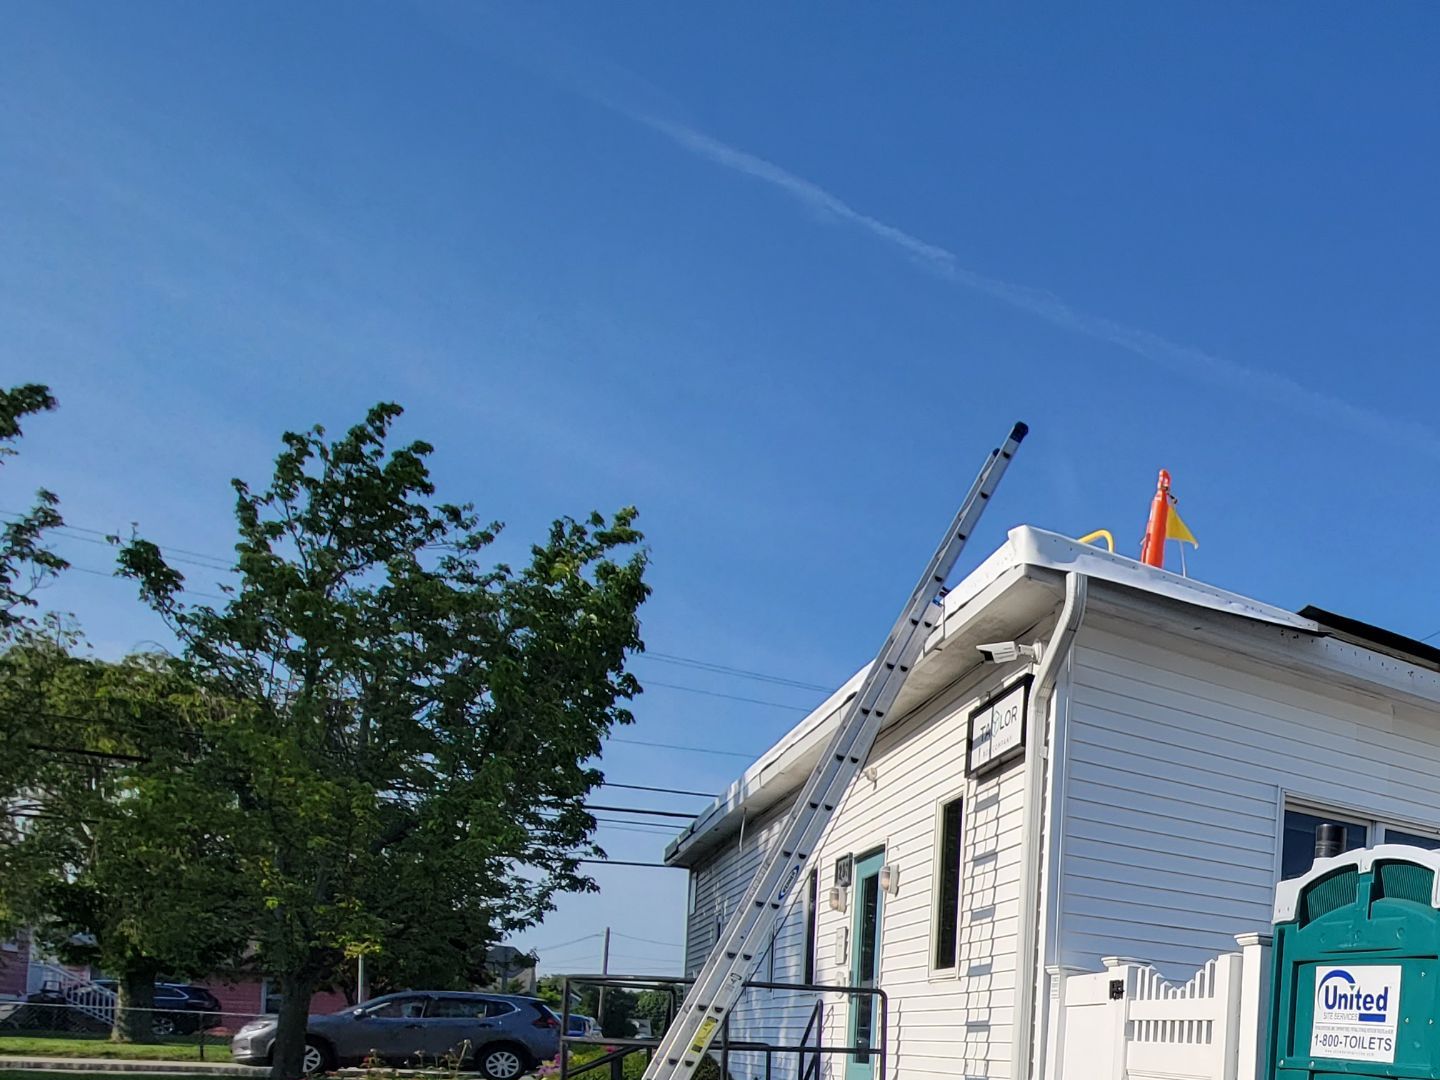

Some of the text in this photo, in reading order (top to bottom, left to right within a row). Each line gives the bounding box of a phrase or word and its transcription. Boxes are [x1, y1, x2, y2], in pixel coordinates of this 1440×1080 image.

[980, 705, 1018, 743] TAYLOR
[1324, 985, 1389, 1011] United
[1315, 1034, 1392, 1051] 1-800-TOILETS
